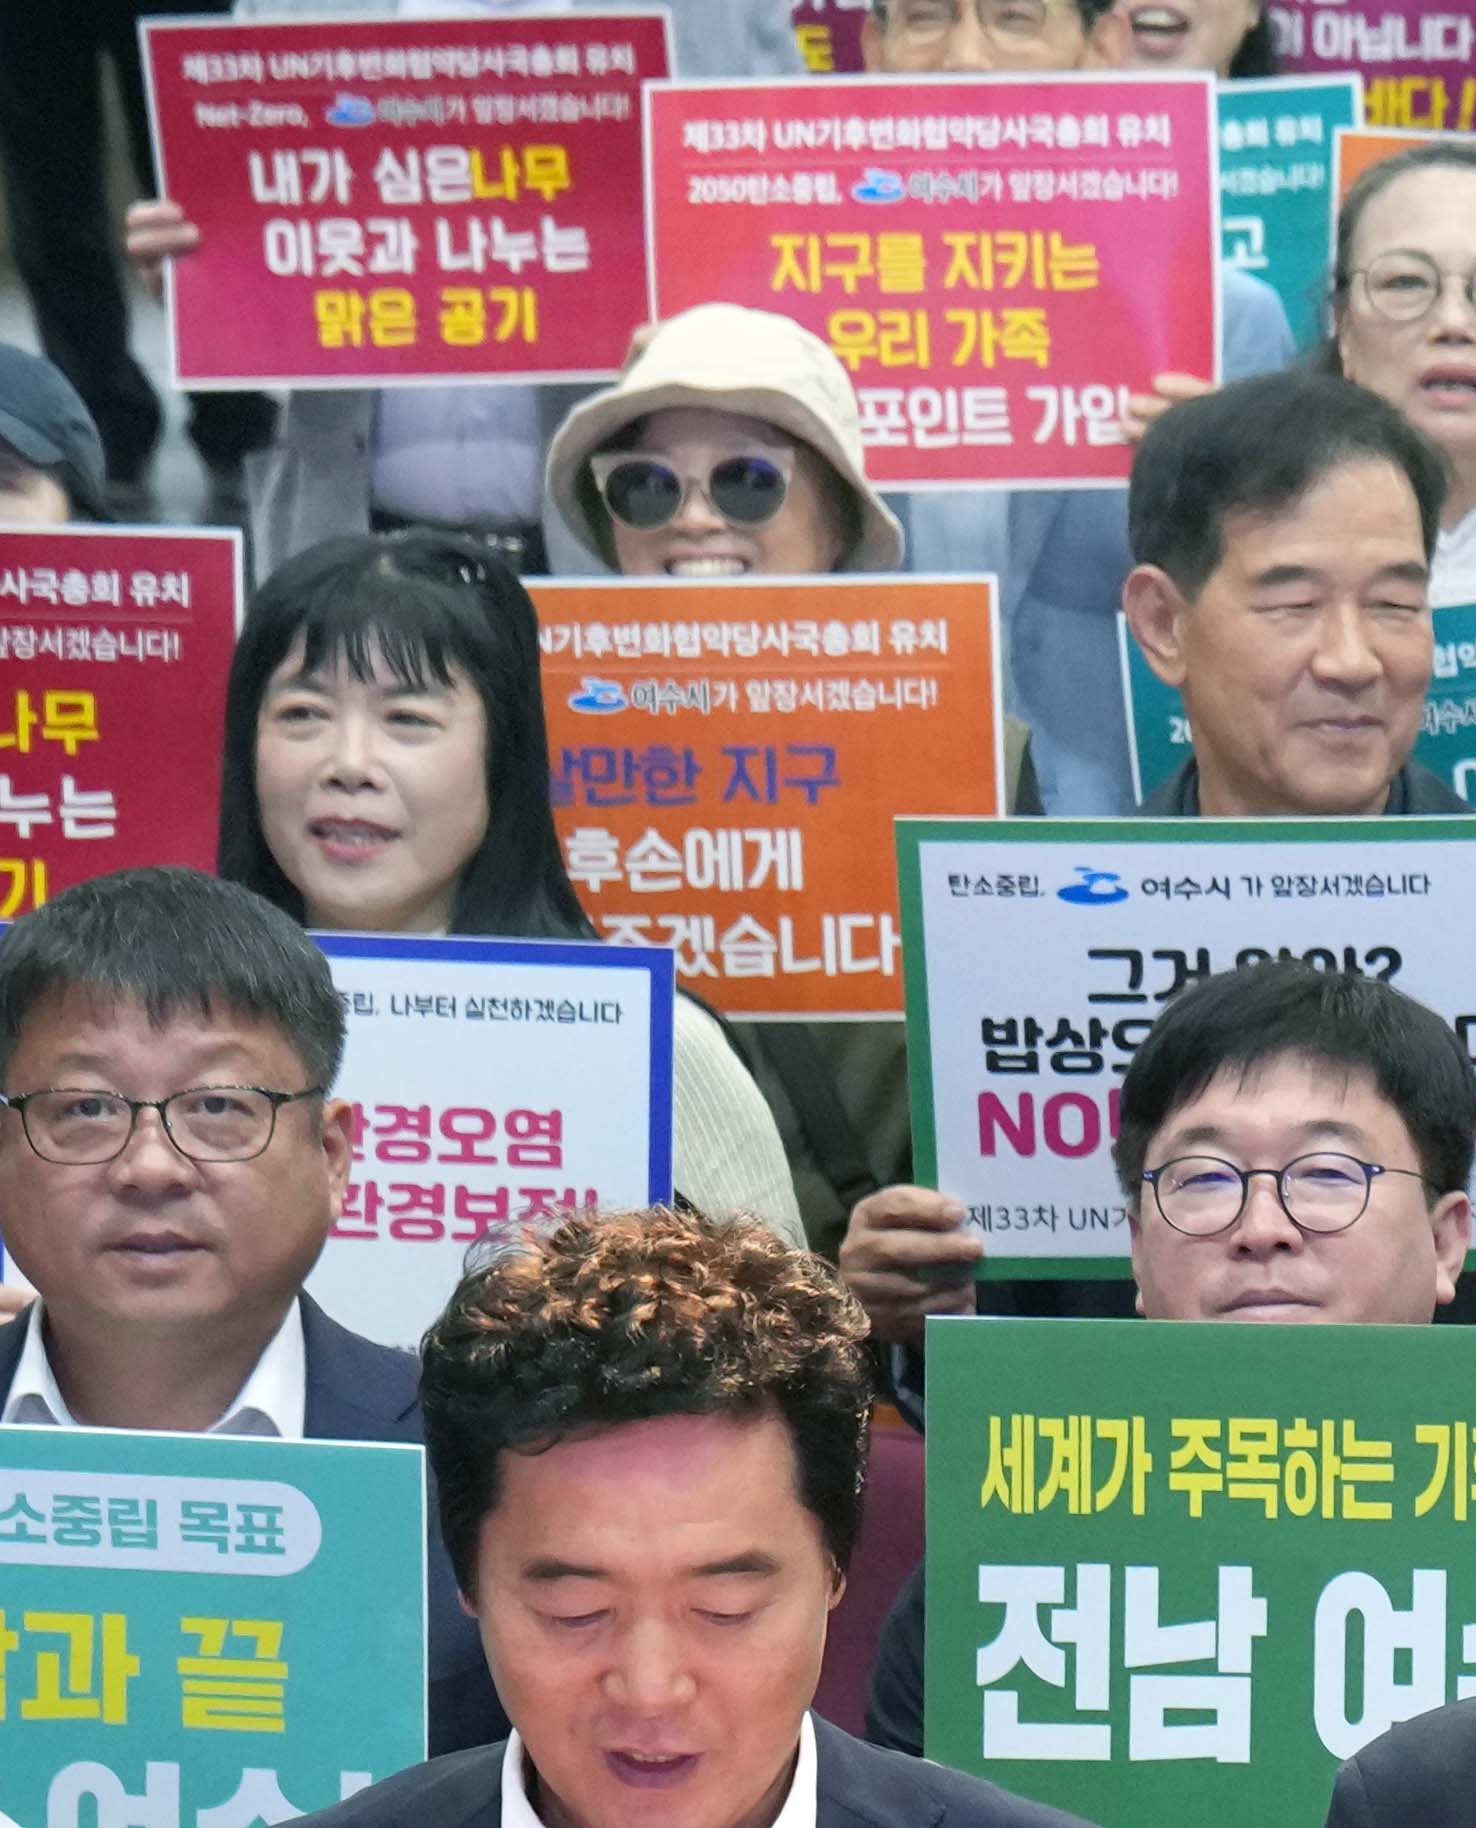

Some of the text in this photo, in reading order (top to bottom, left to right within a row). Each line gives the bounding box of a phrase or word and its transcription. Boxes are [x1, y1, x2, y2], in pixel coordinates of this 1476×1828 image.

[1314, 12, 1475, 61] 아닙니다
[1116, 114, 1171, 147] 유치
[247, 148, 352, 206] 내가
[264, 217, 590, 277] 이웃과 나누는
[771, 233, 1100, 292] 지구를 지키는
[314, 287, 539, 348] 맑은 공기
[828, 309, 1051, 368] 우리 가족
[129, 572, 189, 609] 유치
[889, 620, 947, 654] 유치
[746, 680, 938, 714] 앞장서겠습니다!
[720, 746, 839, 805] 지구
[566, 828, 803, 892] 후손에게
[1141, 872, 1433, 901] 여수시 가 앞장서겠습니다
[390, 994, 623, 1025] 나부터 실천하겠습니다
[967, 1206, 1060, 1233] 제33차
[981, 1414, 1394, 1521] 세계가 주목하는
[179, 1502, 287, 1556] 목표
[976, 1563, 1268, 1764] 전남
